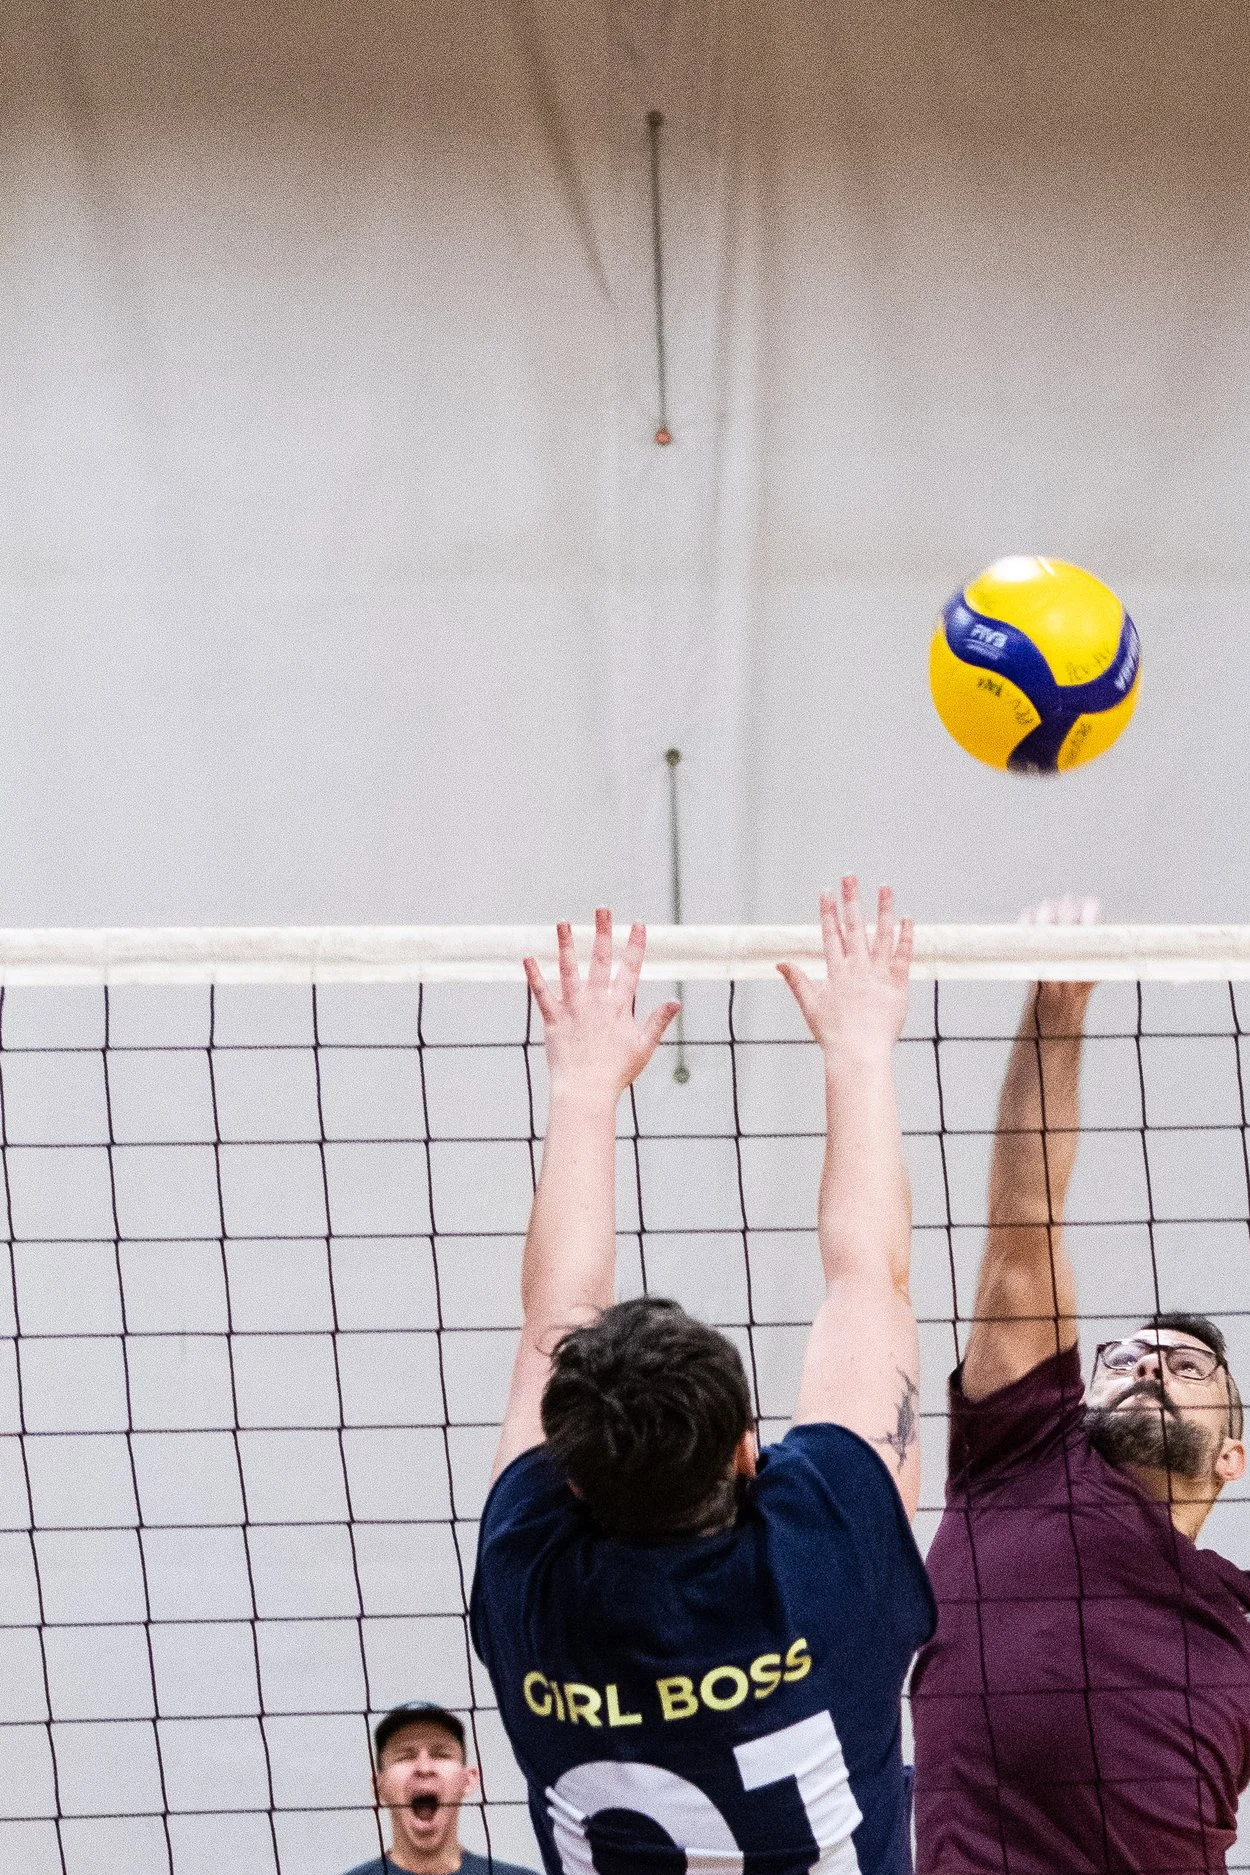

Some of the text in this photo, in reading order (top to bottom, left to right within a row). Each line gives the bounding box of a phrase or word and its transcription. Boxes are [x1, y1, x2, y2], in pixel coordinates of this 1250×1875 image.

[970, 623, 1009, 648] FIVB
[522, 1637, 813, 1728] GIRL BOSS
